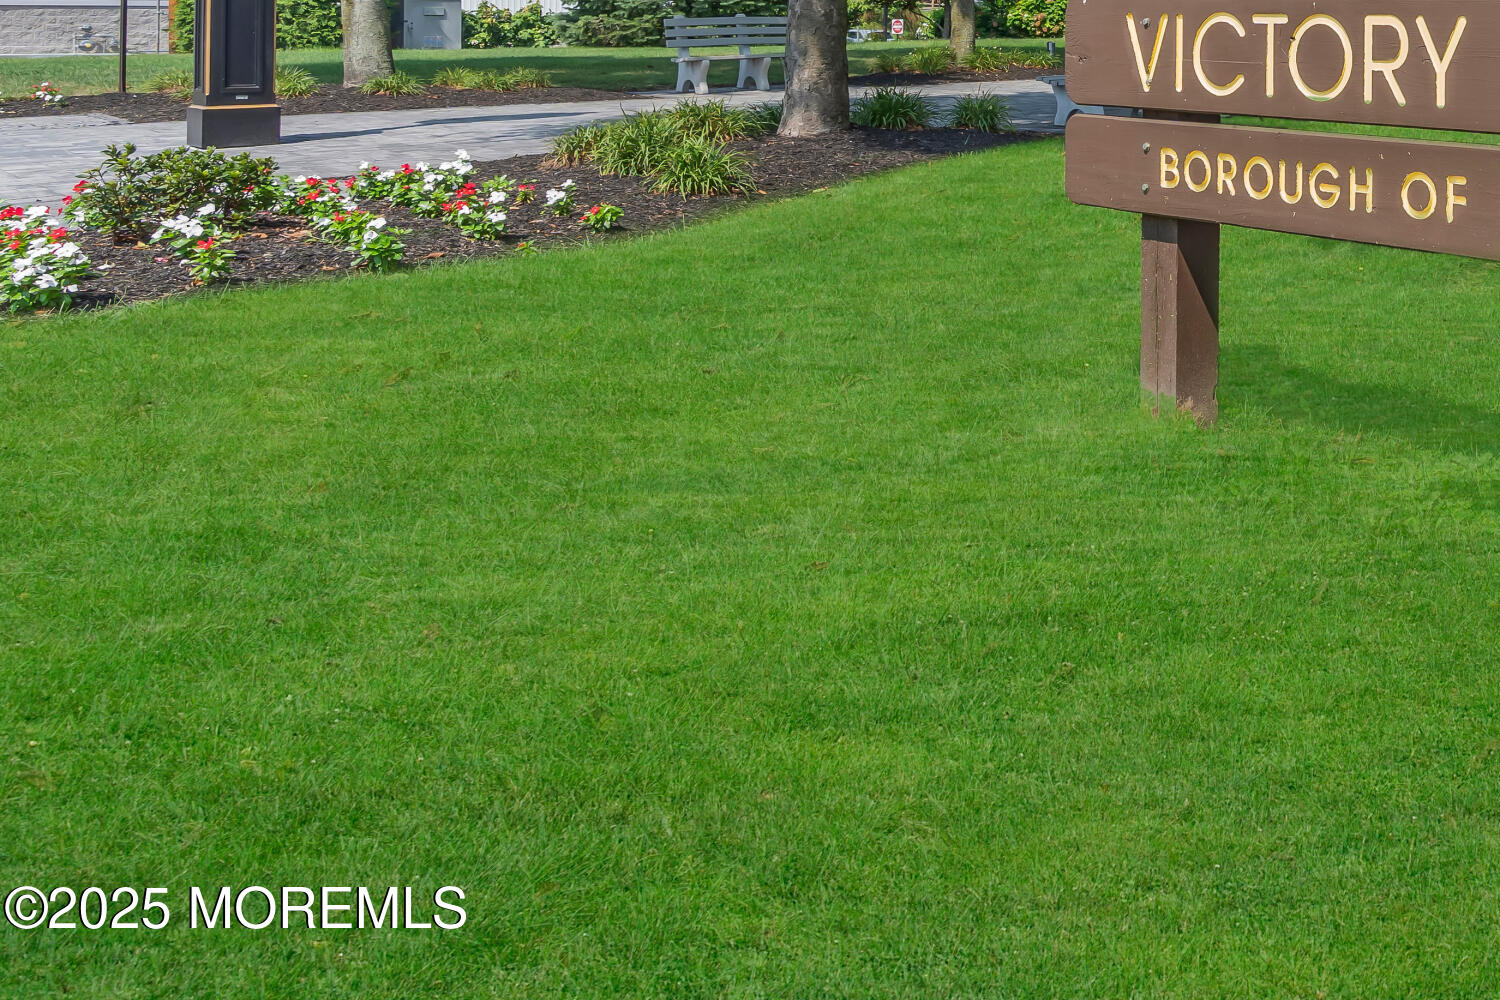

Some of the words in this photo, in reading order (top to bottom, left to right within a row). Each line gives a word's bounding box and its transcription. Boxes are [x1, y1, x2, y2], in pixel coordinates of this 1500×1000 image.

[1126, 12, 1467, 109] VICTORY
[1160, 147, 1373, 213] BOROUGH
[1401, 171, 1467, 224] OF
